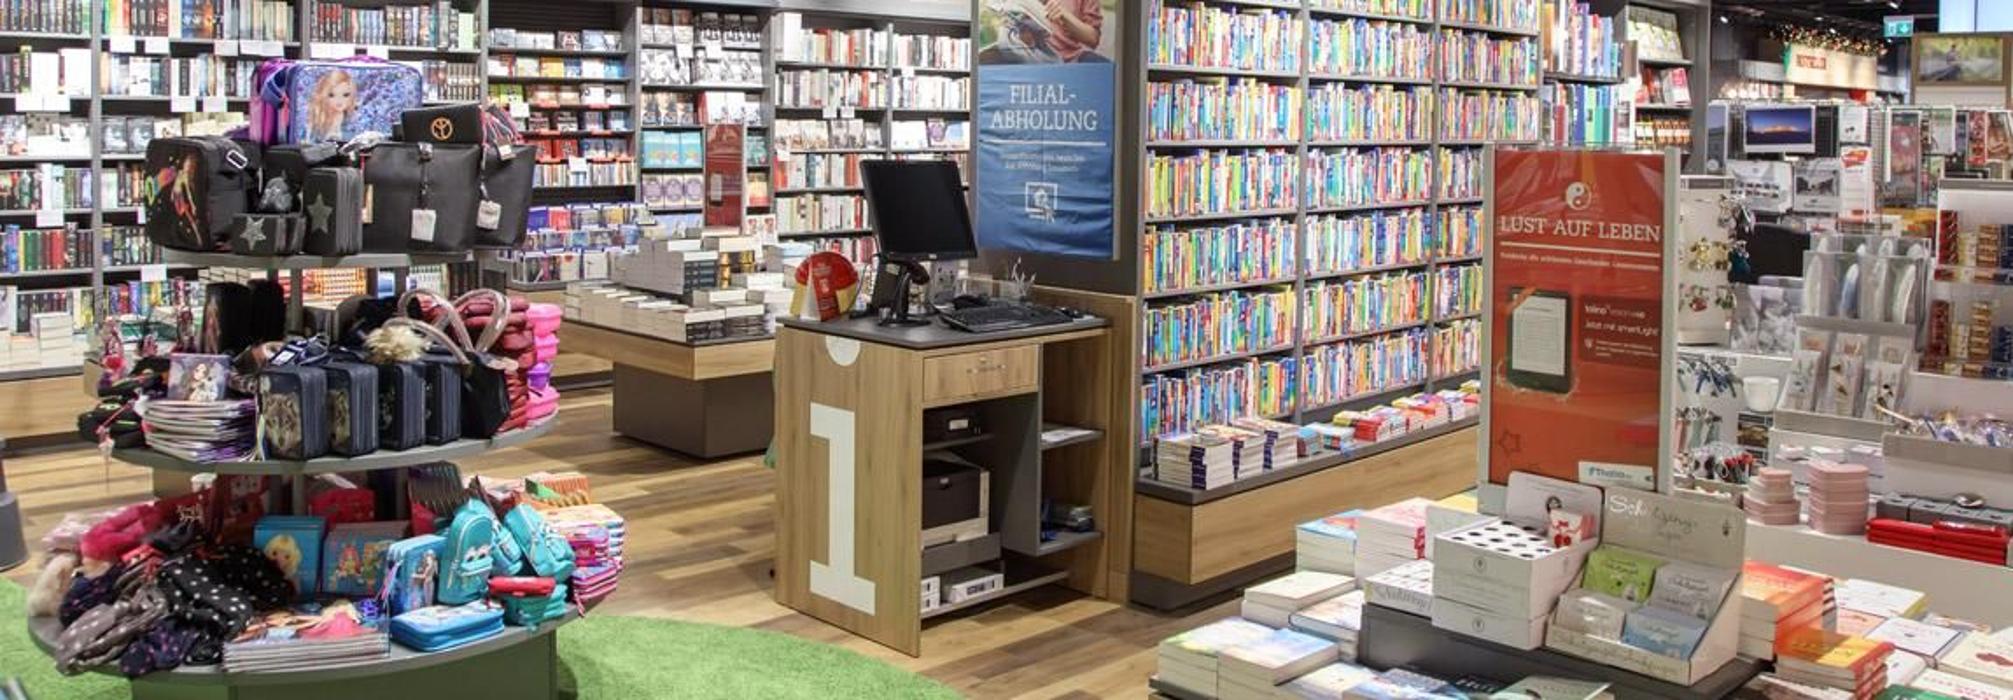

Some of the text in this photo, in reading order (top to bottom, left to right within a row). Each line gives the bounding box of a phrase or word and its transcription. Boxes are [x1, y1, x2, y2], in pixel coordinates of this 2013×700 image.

[1008, 84, 1077, 105] FILIAL-
[990, 109, 1098, 131] ABHOLUNG
[1500, 215, 1661, 242] LUST AUF LEBEN
